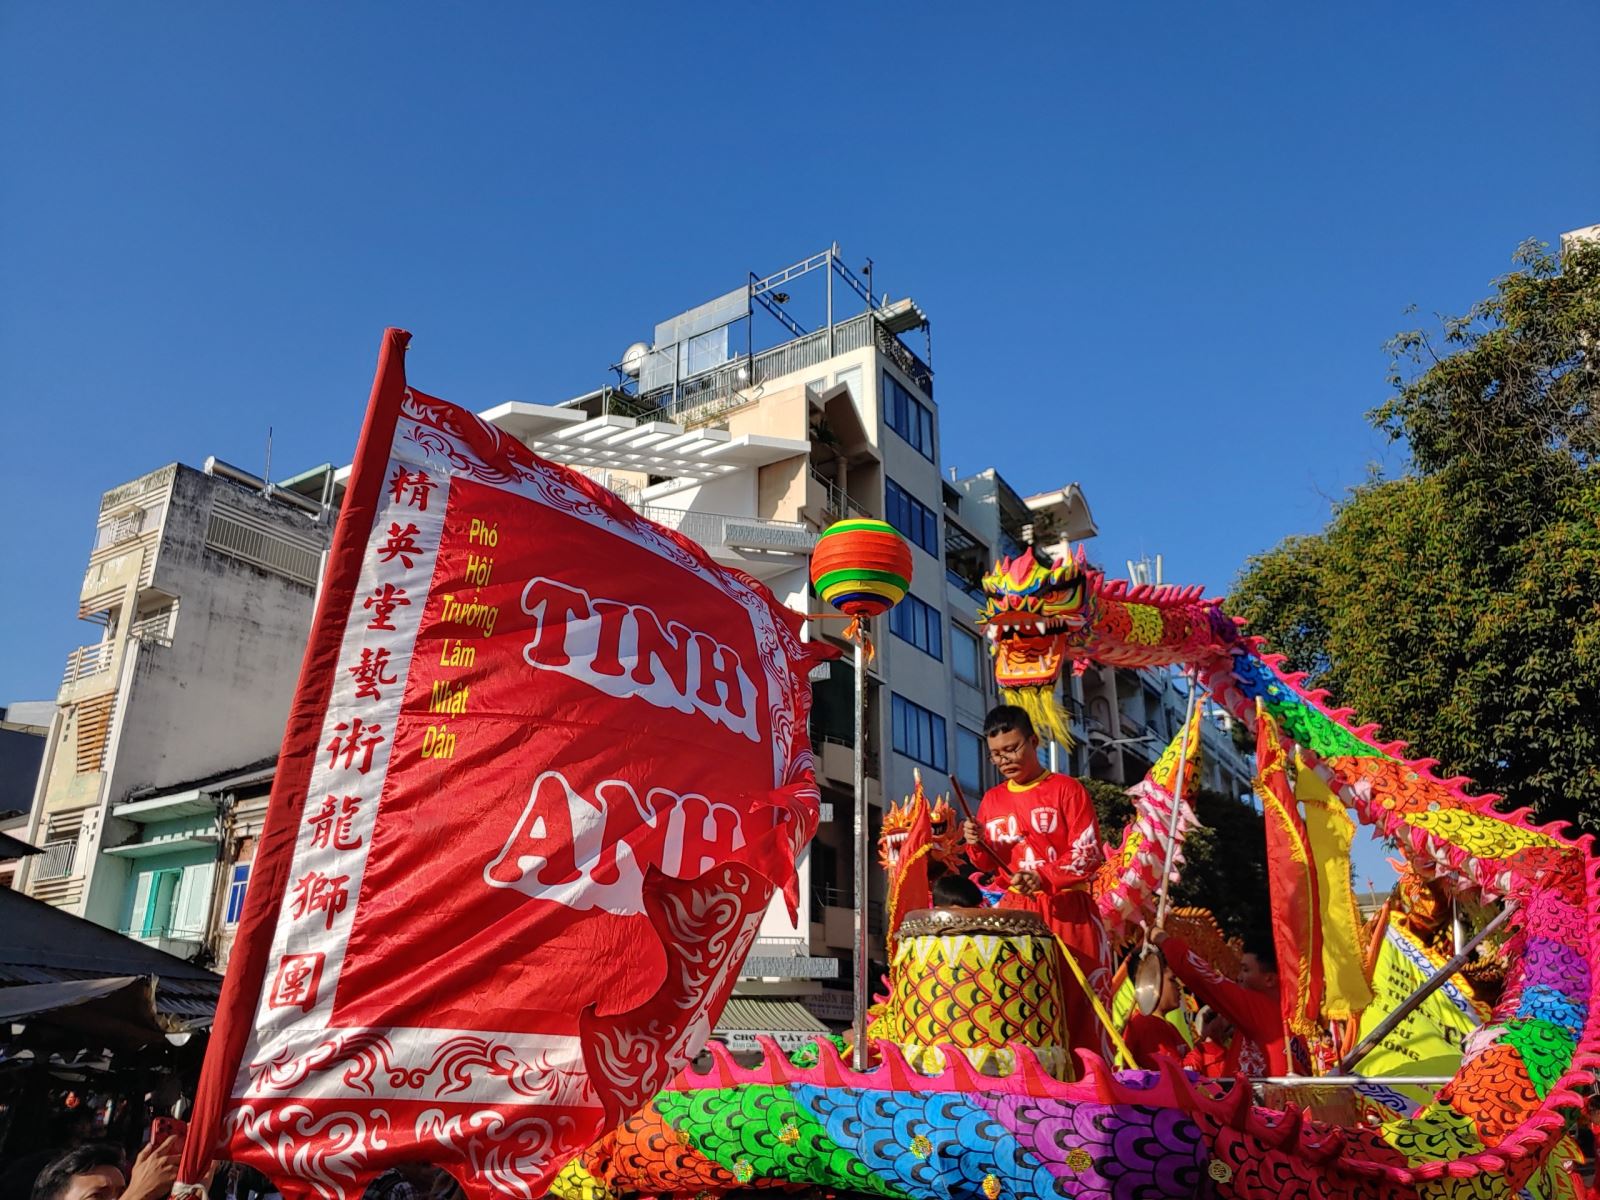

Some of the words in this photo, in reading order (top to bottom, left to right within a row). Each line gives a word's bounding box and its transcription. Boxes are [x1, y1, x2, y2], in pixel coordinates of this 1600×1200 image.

[469, 518, 498, 548] Phó
[465, 555, 494, 592] Hội
[440, 594, 499, 638] Trưởng
[440, 639, 476, 668] Lâm
[520, 576, 761, 742] TINH
[429, 680, 470, 719] Nhật
[422, 725, 456, 760] Dân
[483, 771, 748, 917] ANH
